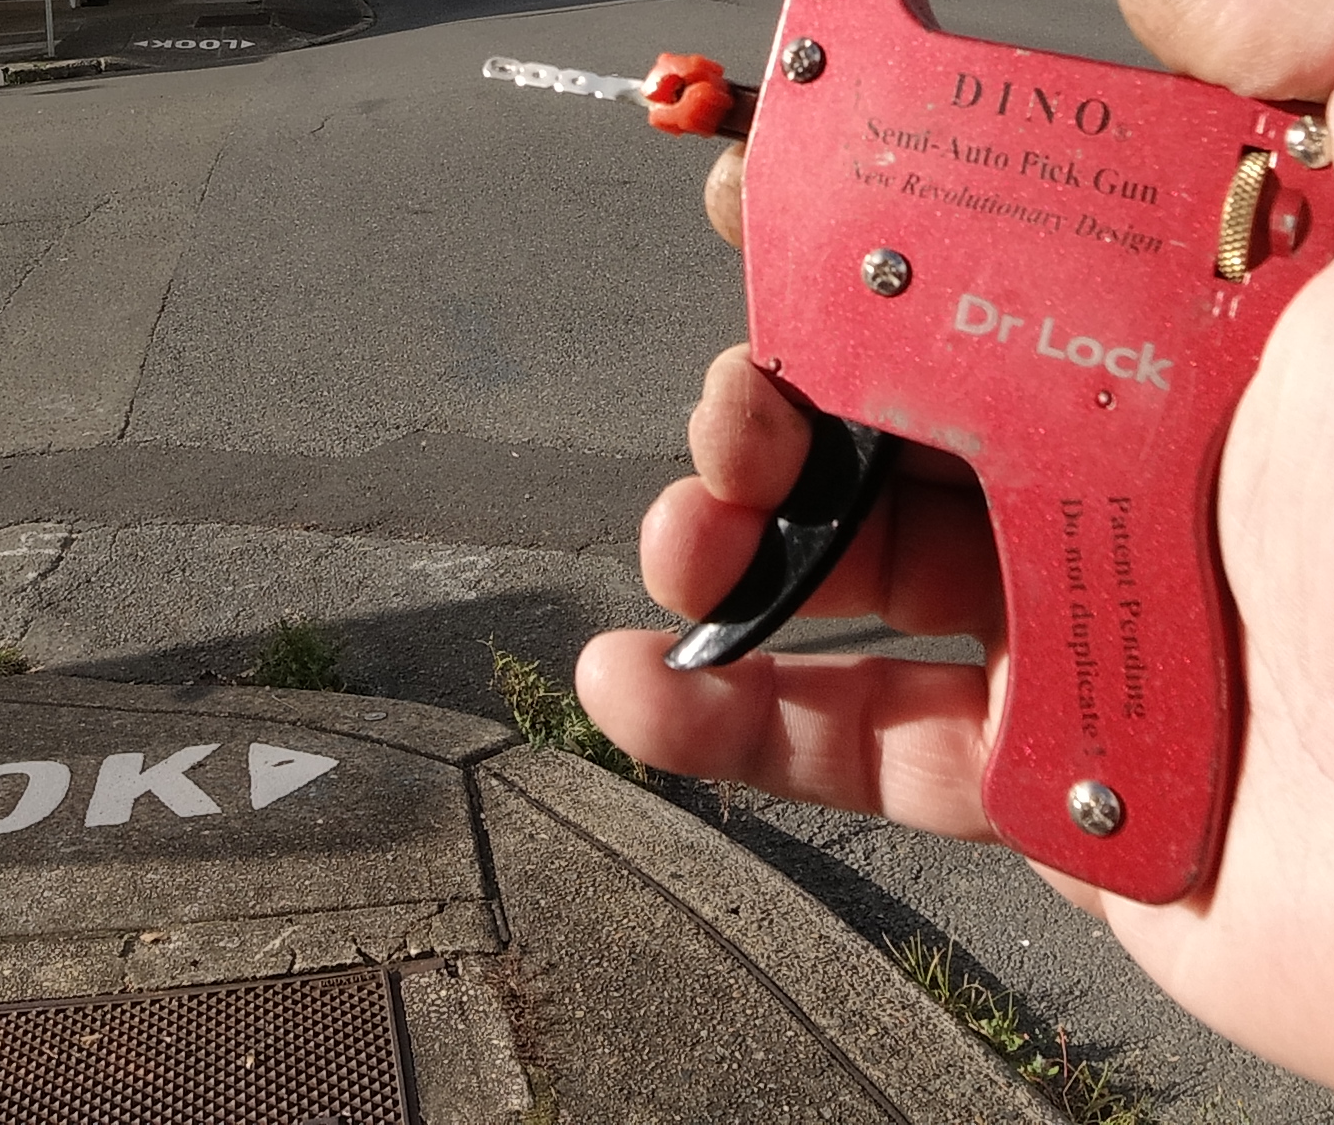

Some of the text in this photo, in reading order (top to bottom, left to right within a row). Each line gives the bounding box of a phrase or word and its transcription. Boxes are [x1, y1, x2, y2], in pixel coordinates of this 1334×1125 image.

[151, 39, 238, 50] LOOK
[864, 117, 1159, 206] Semi-Auto Pick Gun
[847, 159, 1164, 256] New Revolutionary Design
[955, 293, 1175, 392] Dr Lock
[1060, 497, 1083, 538] Do
[1065, 547, 1088, 592] not
[1108, 496, 1148, 720] Patent Pending
